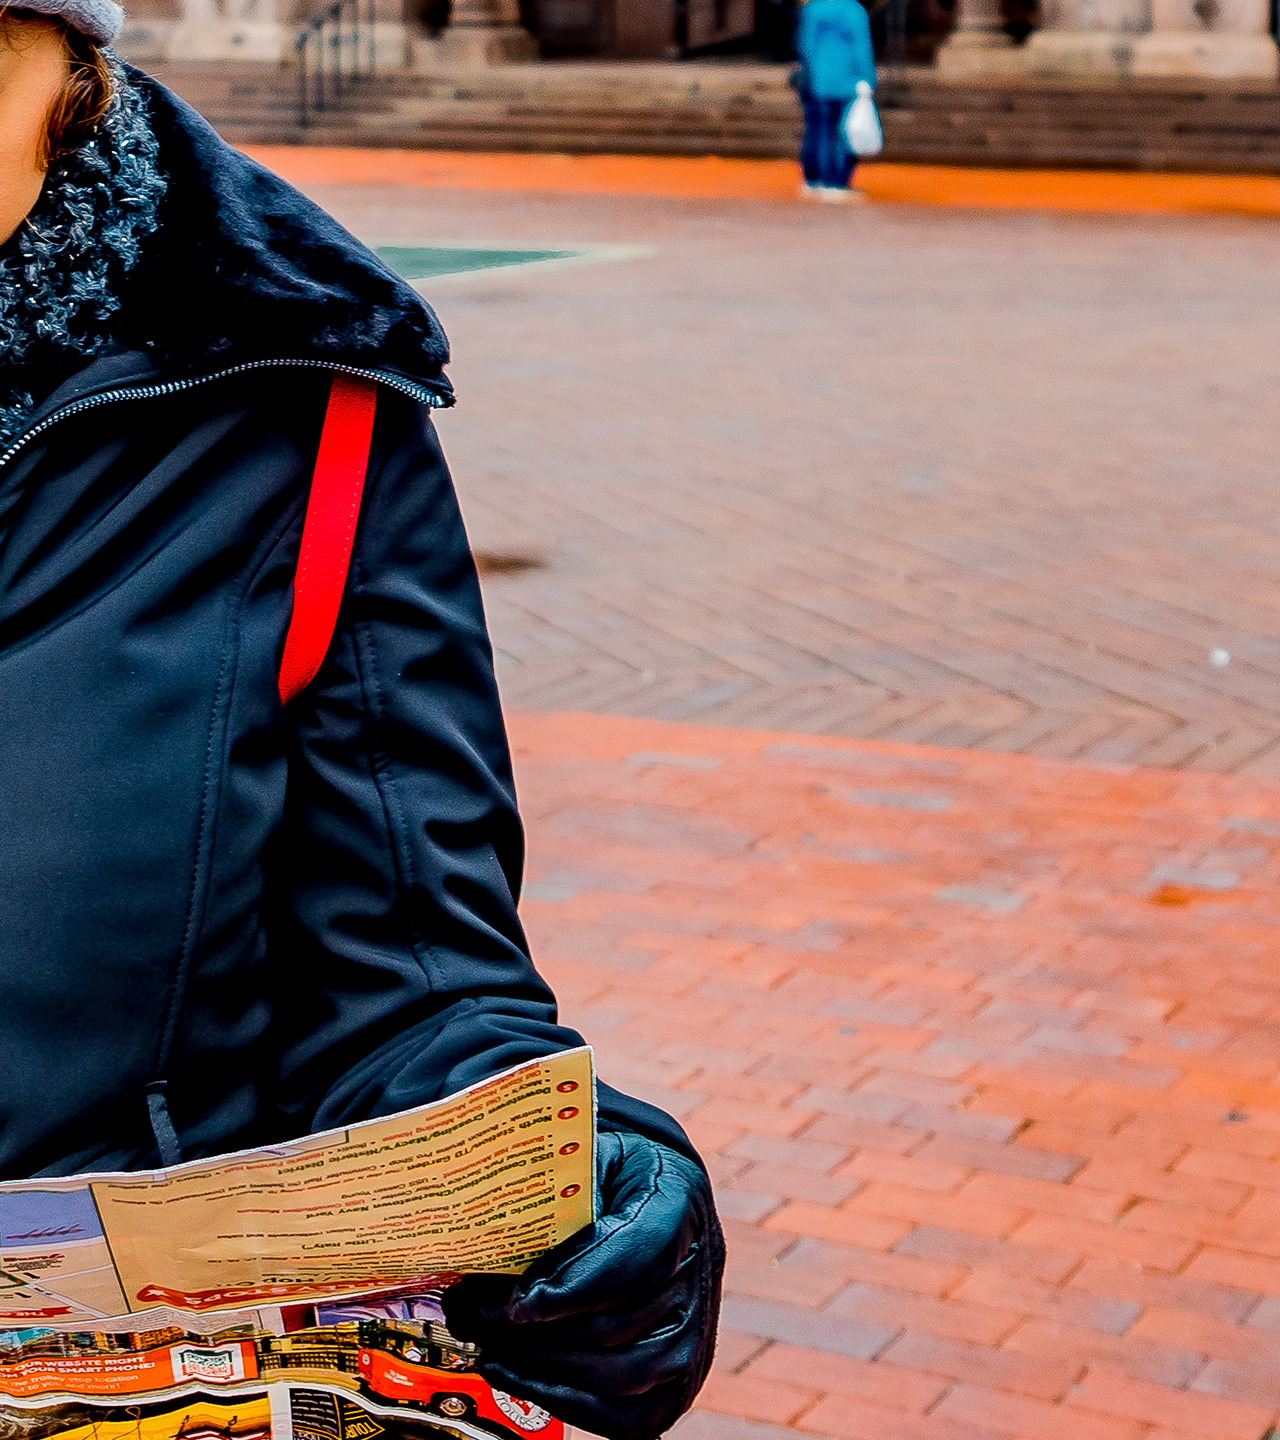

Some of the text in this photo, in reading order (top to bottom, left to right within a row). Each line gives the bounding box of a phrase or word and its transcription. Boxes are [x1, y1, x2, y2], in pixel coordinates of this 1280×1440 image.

[488, 1087, 551, 1114] Downtown
[510, 1108, 543, 1122] Amtrak
[407, 1115, 552, 1170] North Station/TD Garden
[507, 1145, 545, 1160] National
[531, 1152, 554, 1164] USS
[278, 1161, 324, 1175] District
[389, 1157, 413, 1166] Shop
[484, 1159, 504, 1170] Park
[373, 1159, 527, 1208] Constitution/Charlestown
[505, 1171, 546, 1188] Maritime
[464, 1186, 502, 1205] Museum
[339, 1206, 368, 1214] Navy
[511, 1195, 555, 1214] Historic
[306, 1211, 334, 1219] Yard
[475, 1212, 506, 1227] North
[448, 1224, 470, 1233] End
[15, 1361, 43, 1371] OUR
[105, 1356, 146, 1364] RIGHT
[20, 1367, 55, 1376] YOUR
[105, 1362, 156, 1371] PHONE!
[30, 1374, 65, 1382] trolley
[41, 1381, 62, 1389] you
